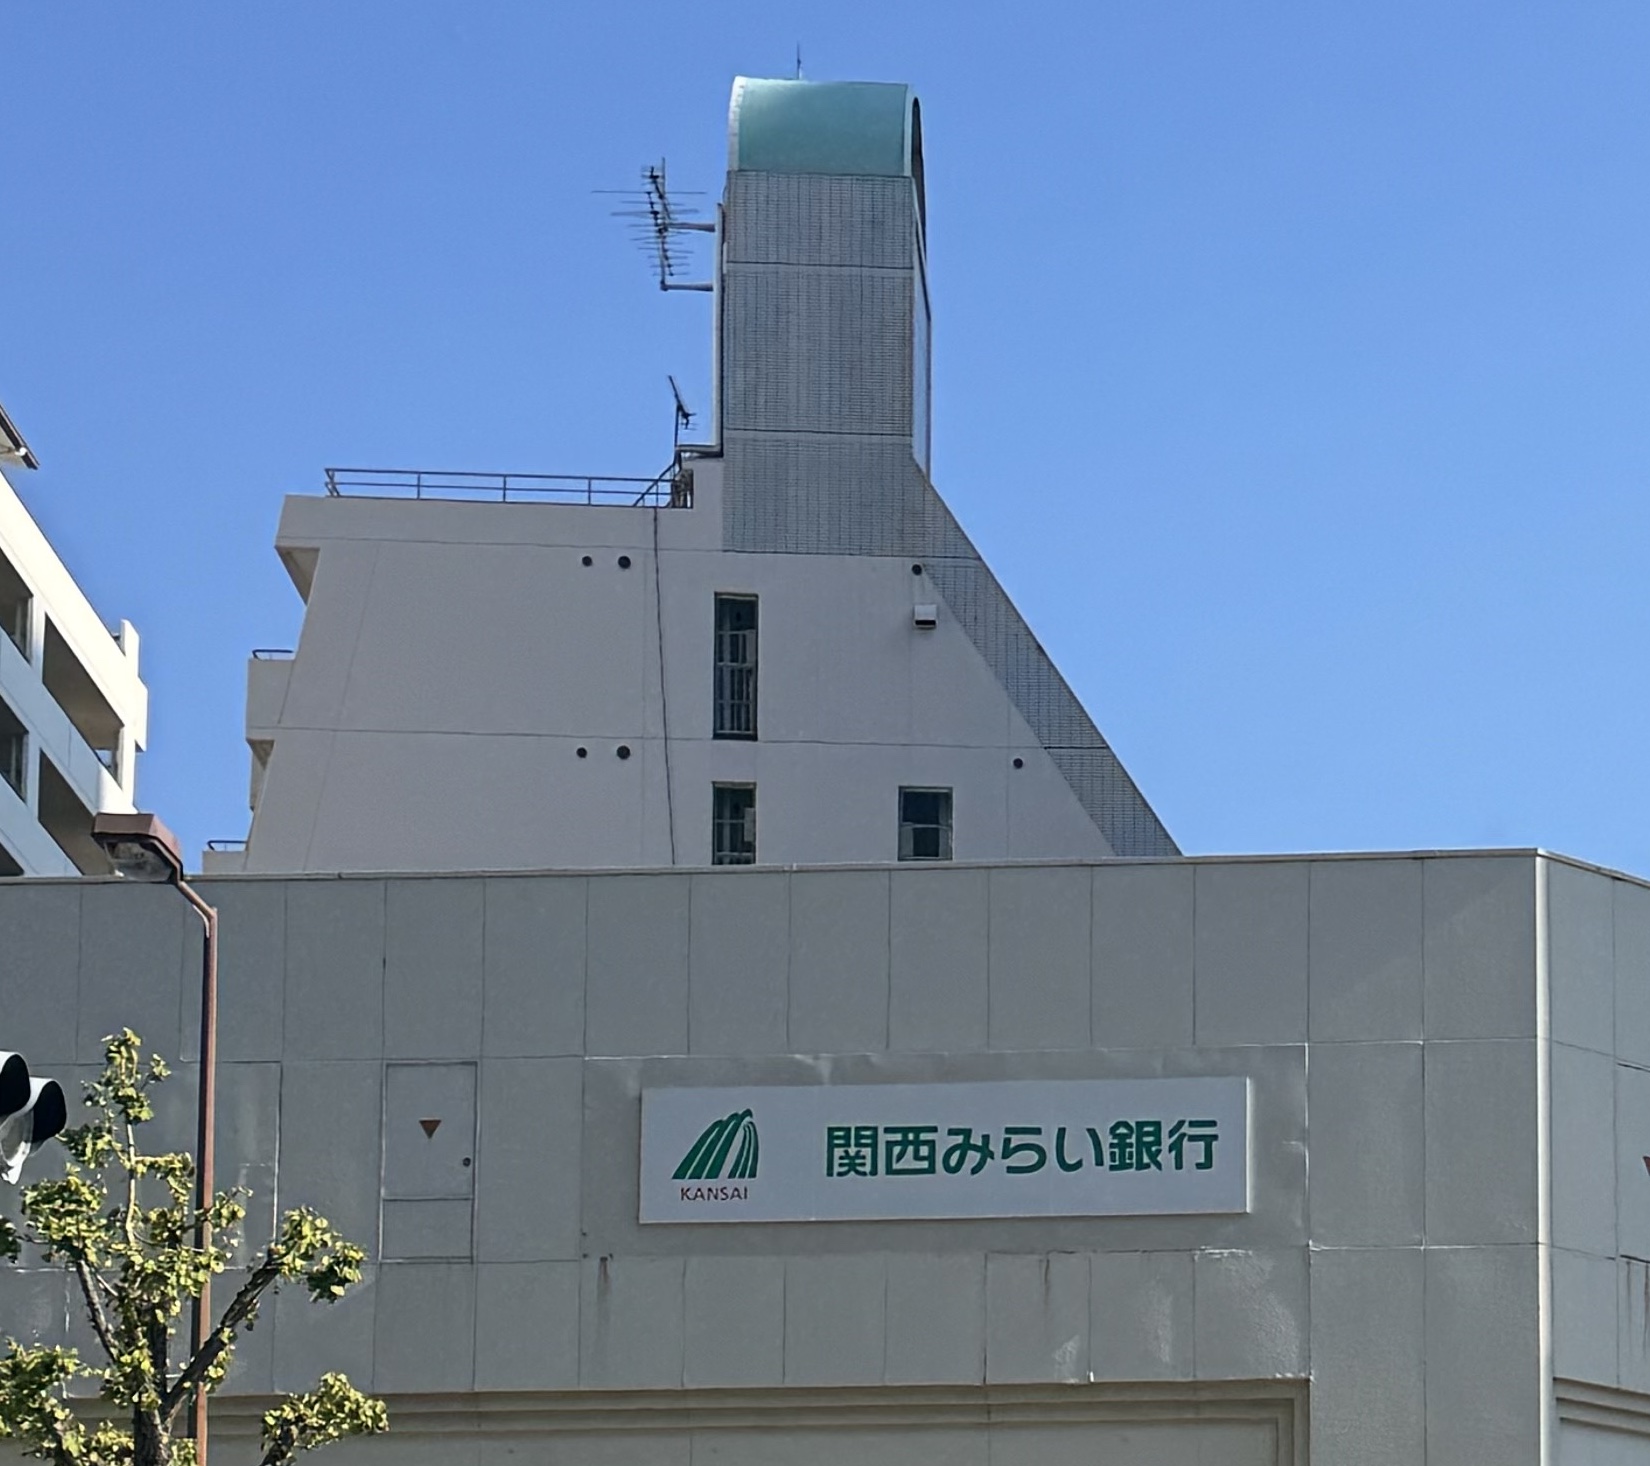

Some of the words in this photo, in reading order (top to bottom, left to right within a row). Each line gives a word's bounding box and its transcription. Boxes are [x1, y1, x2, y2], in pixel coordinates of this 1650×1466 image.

[826, 1119, 1219, 1177] 関西みらい銀行
[680, 1186, 748, 1201] KANSAI
